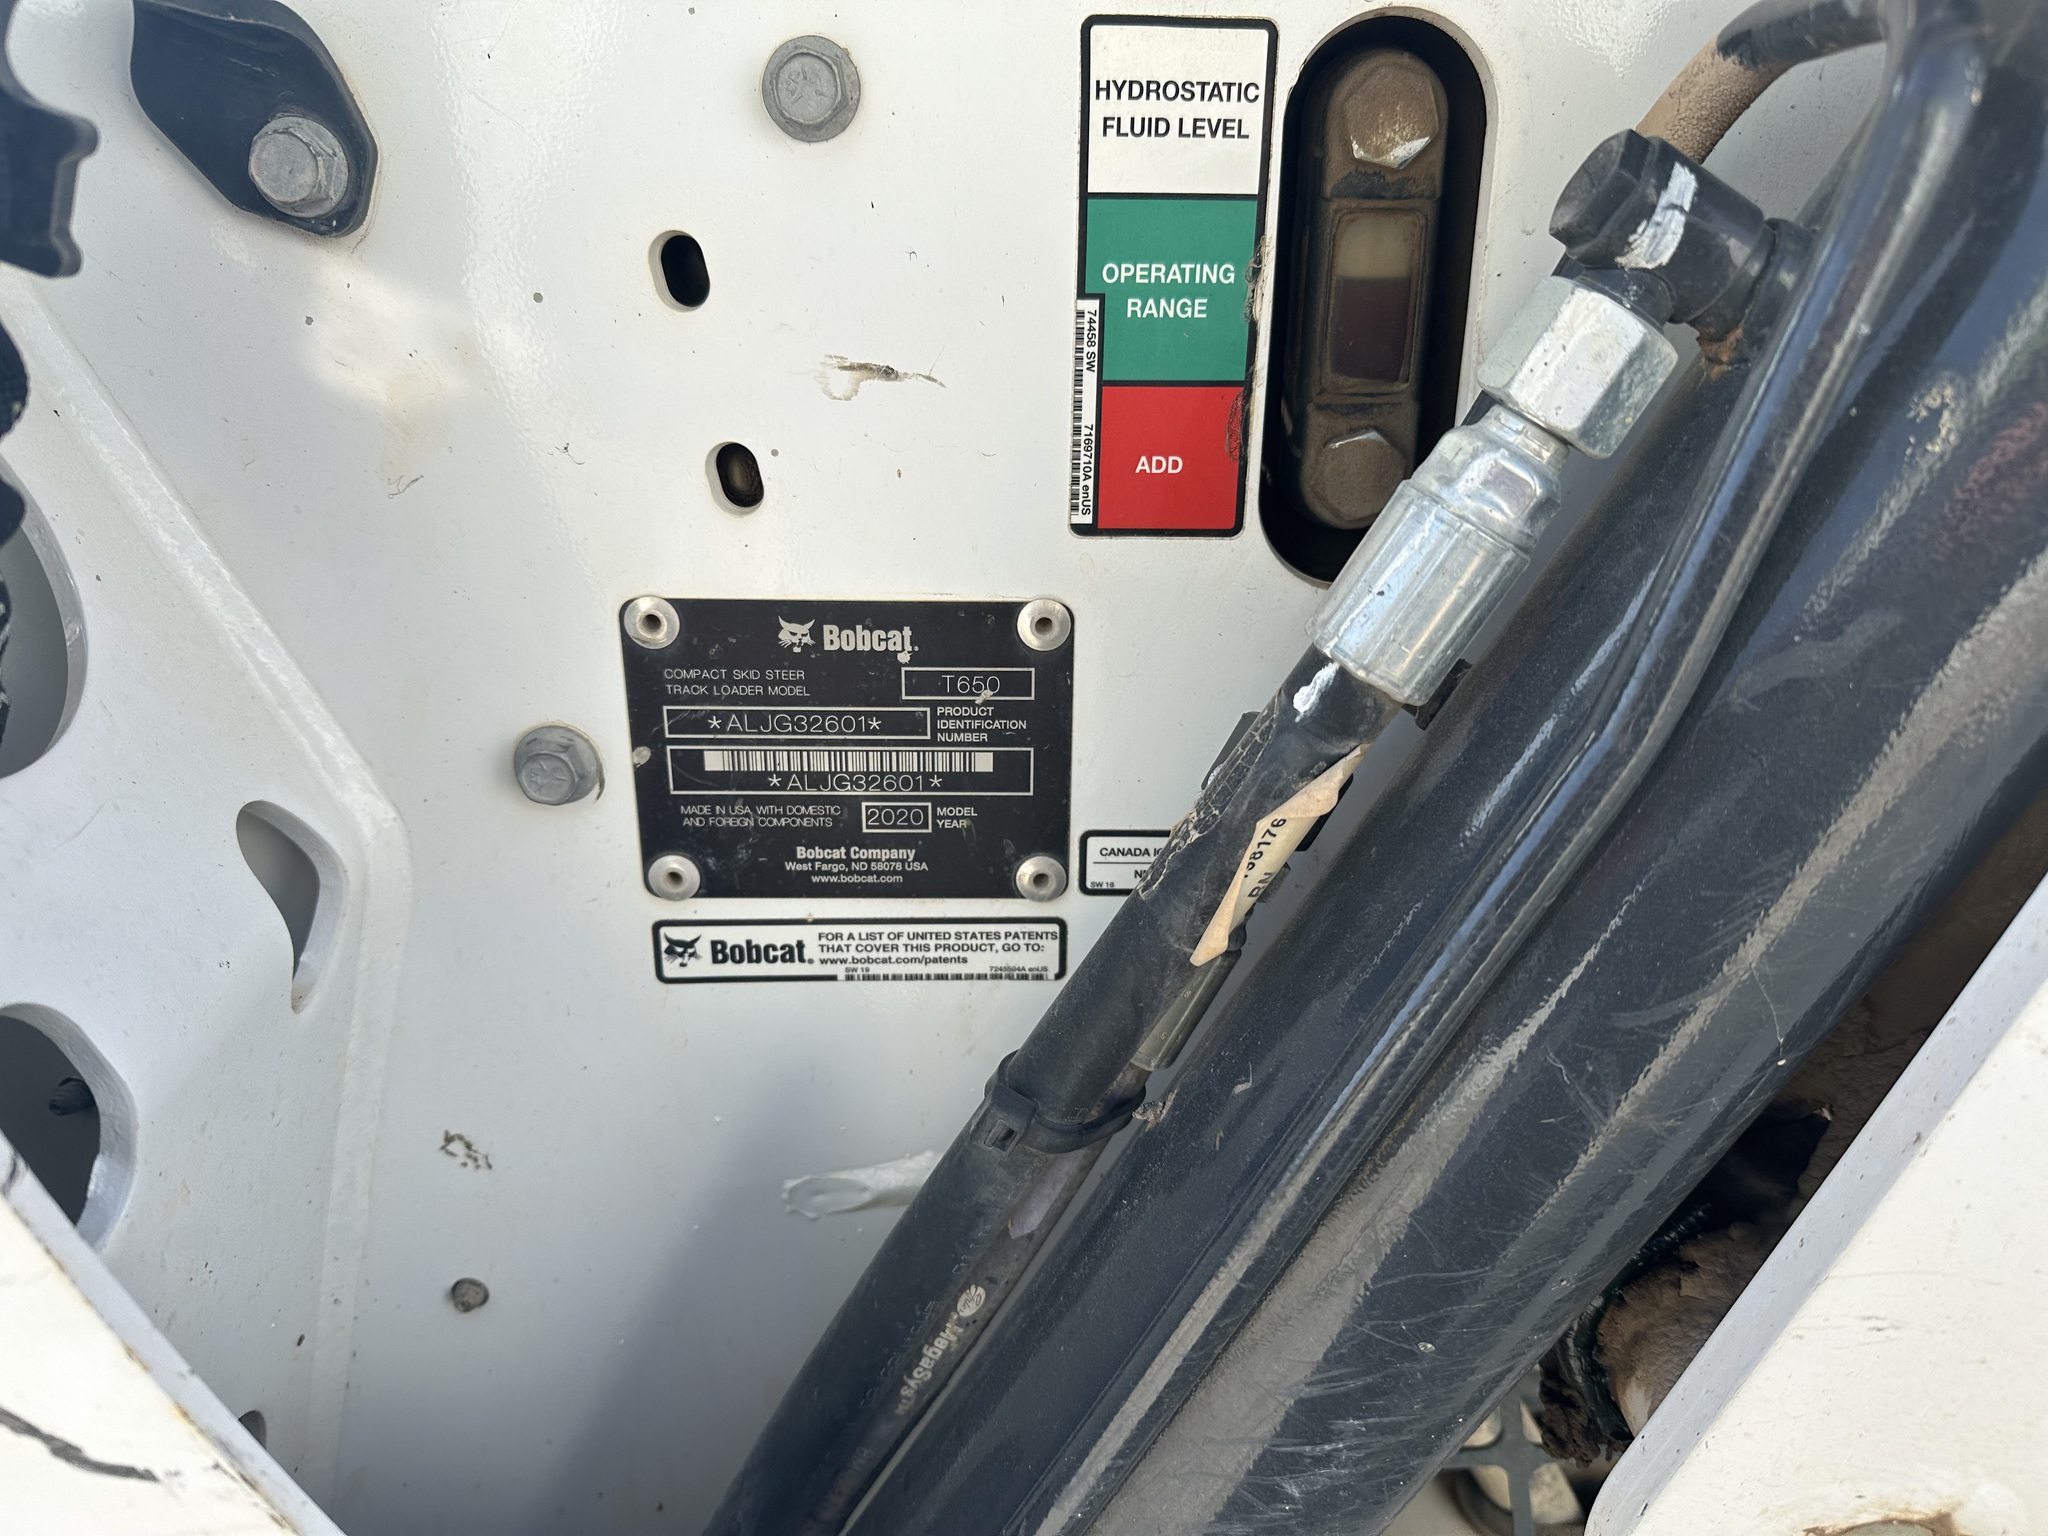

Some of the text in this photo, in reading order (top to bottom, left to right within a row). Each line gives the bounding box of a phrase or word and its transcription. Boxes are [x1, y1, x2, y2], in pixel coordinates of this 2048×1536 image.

[1095, 79, 1260, 103] HYDROSTATIC
[1102, 117, 1249, 139] FLUID LEVEL
[1102, 263, 1235, 284] OPERATING
[1126, 299, 1208, 318] RANGE
[1086, 309, 1097, 373] 74458 SW
[1081, 424, 1093, 516] 7169710A enUS
[1135, 456, 1183, 474] ADD
[664, 668, 805, 681] COMPACT SKID STEER
[942, 674, 1000, 694] T650
[666, 684, 810, 697] TRACK LOADER MODEL
[936, 706, 994, 717] PRODUCT
[936, 719, 1027, 730] IDENTIFICATION
[936, 732, 988, 743] NUMBER
[680, 805, 711, 815] MADE
[716, 805, 726, 815] IN
[756, 805, 783, 815] WITH
[787, 805, 841, 815] DOMESTIC
[936, 807, 977, 817] MODEL
[683, 817, 833, 828] AND FOREIGN COMPONENTS
[867, 808, 924, 826] 2020
[936, 819, 968, 829] YEAR
[796, 846, 916, 861] Bobcat Company
[1100, 847, 1150, 857] CANADA
[785, 861, 928, 873] West Fargo, ND 58078 USA
[812, 874, 903, 884] www.bobcat.com
[818, 931, 1058, 942] FOR A LIST OF UNITED STATES PATENTS
[819, 943, 1045, 954] THAT COVER THIS PRODUCT, GO TO:
[819, 955, 968, 966] www.bobcat.com/patents
